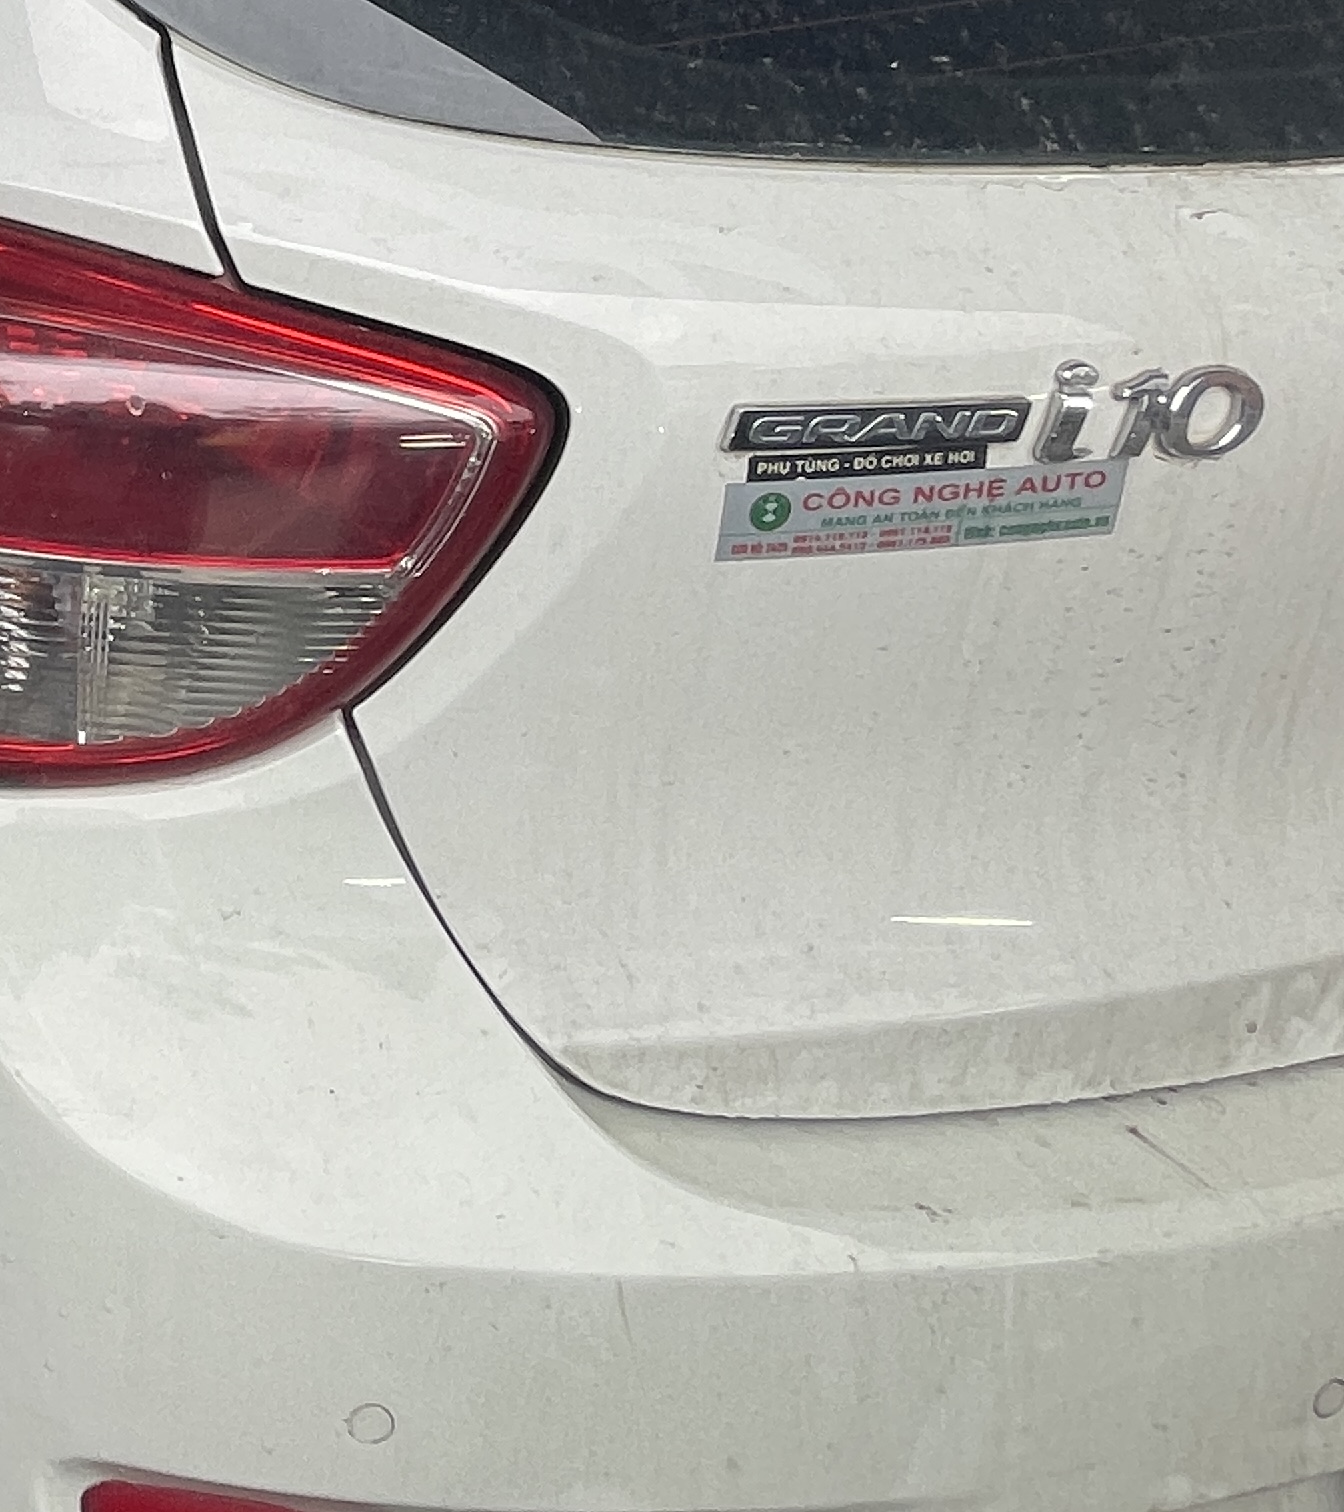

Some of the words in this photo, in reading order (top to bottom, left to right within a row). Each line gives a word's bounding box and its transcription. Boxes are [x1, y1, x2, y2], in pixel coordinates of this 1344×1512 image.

[748, 407, 1019, 444] GRAND
[1032, 358, 1264, 465] i10
[756, 461, 792, 475] PHỤ
[795, 456, 840, 473] TÙNG
[923, 452, 944, 466] XE
[803, 487, 901, 511] CÔNG
[912, 477, 1008, 504] NGHỆ
[1015, 470, 1107, 496] AUTO
[821, 514, 868, 528] MANG
[872, 512, 894, 524] AN
